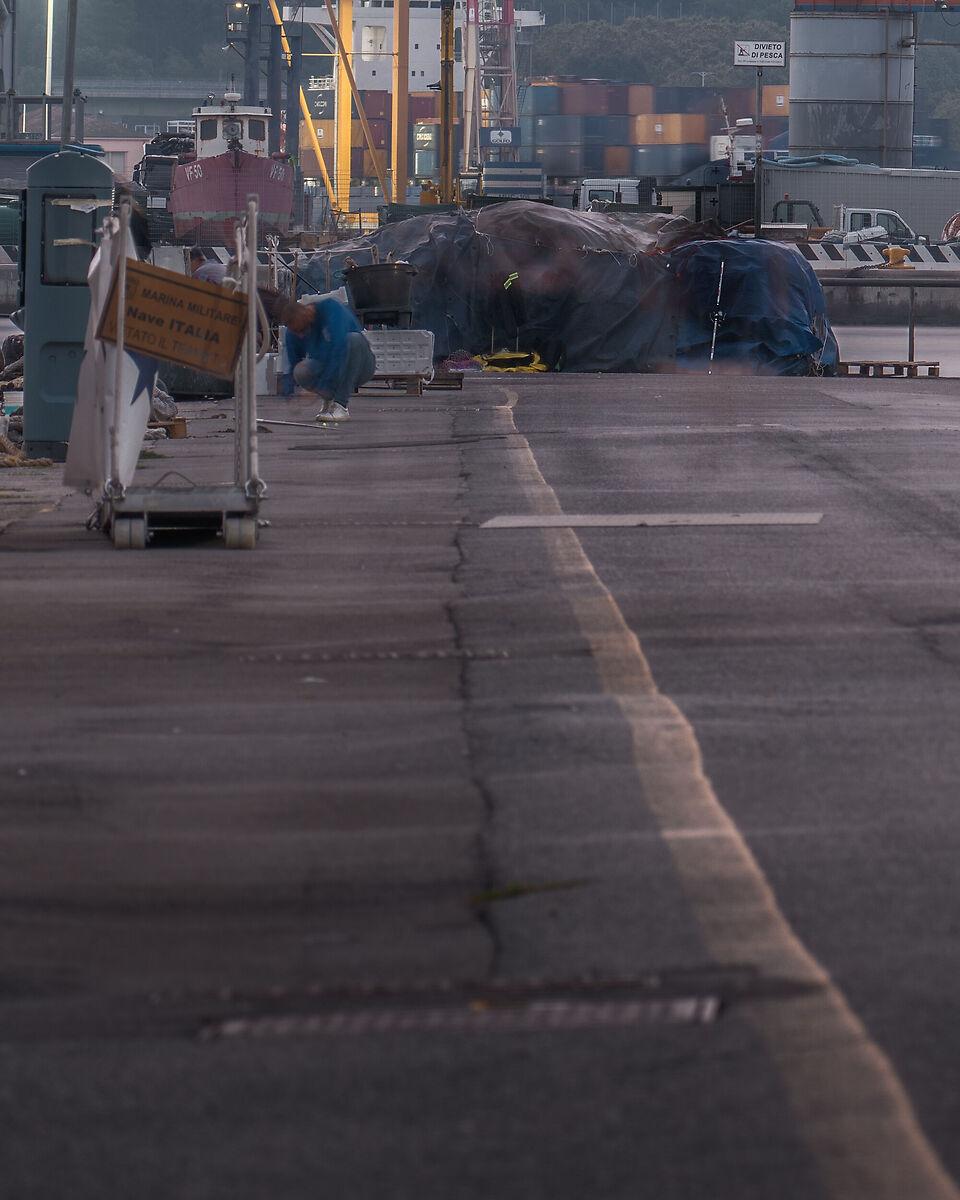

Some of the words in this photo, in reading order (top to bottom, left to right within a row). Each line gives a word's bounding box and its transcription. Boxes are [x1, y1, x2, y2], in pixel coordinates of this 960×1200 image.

[184, 165, 193, 181] VF
[193, 164, 203, 179] 50
[142, 288, 184, 310] MARINA
[187, 302, 239, 326] MILITARE
[108, 319, 157, 346] VTATO
[127, 305, 164, 327] Nave
[168, 319, 220, 344] ITALIA
